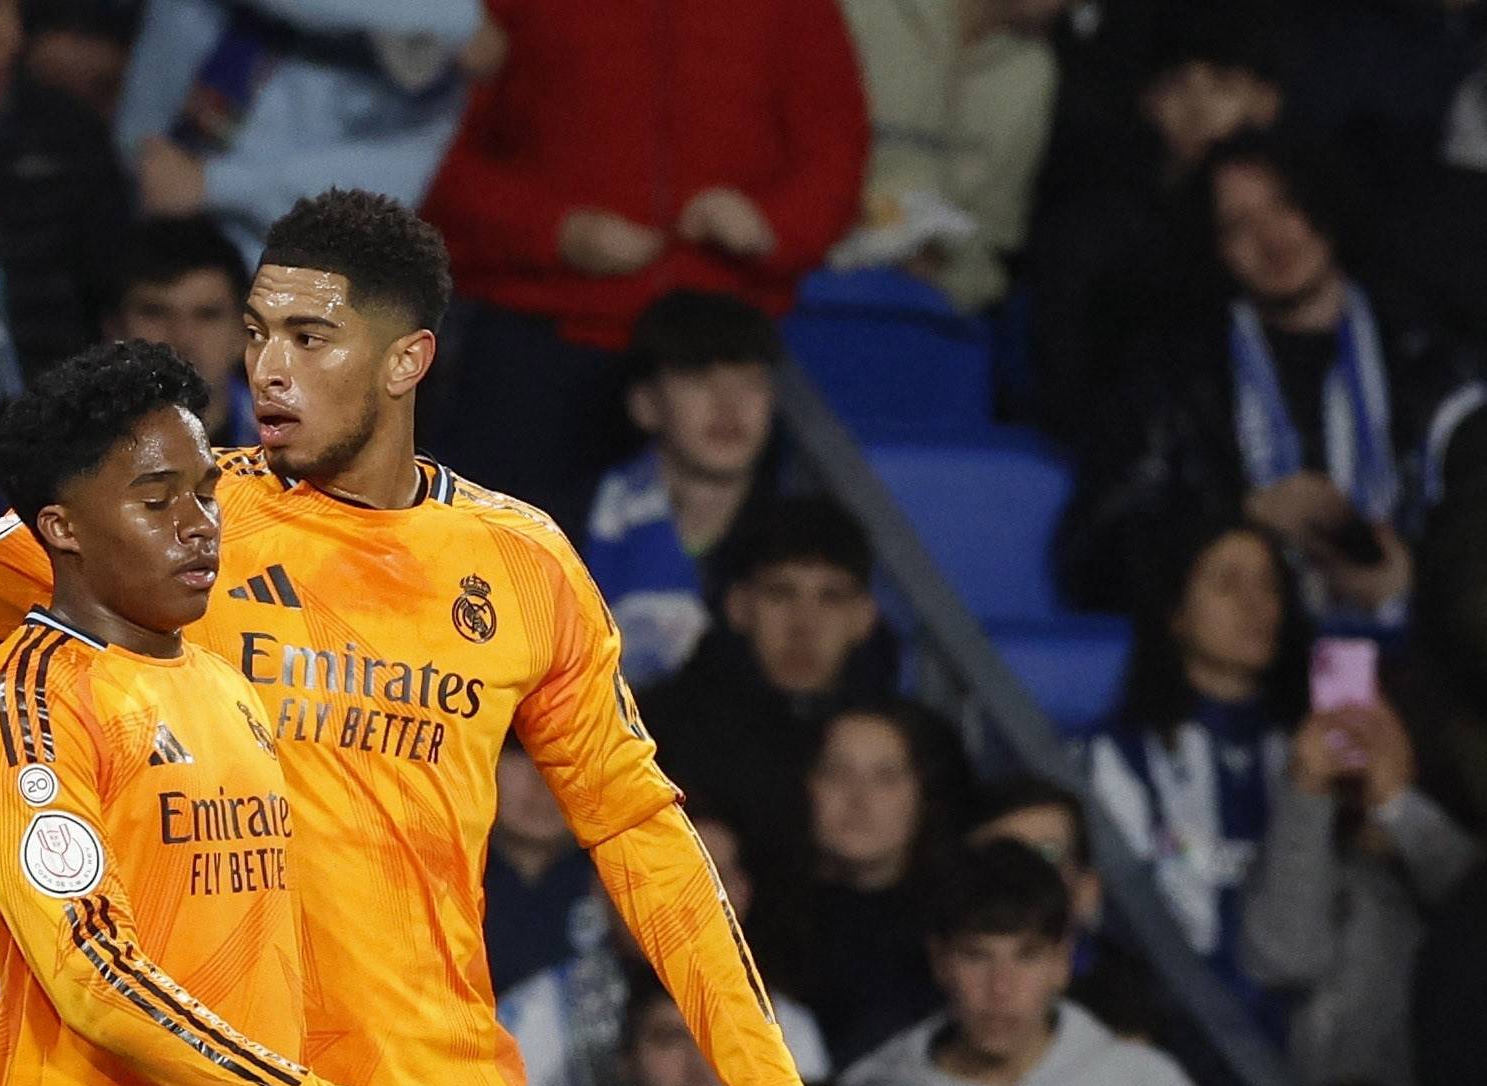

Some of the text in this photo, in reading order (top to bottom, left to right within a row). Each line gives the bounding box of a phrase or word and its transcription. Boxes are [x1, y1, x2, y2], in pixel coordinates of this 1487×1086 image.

[240, 632, 484, 719] Emirates
[277, 698, 445, 764] FLY BETTER
[27, 777, 48, 793] 20
[191, 852, 221, 896] FLY
